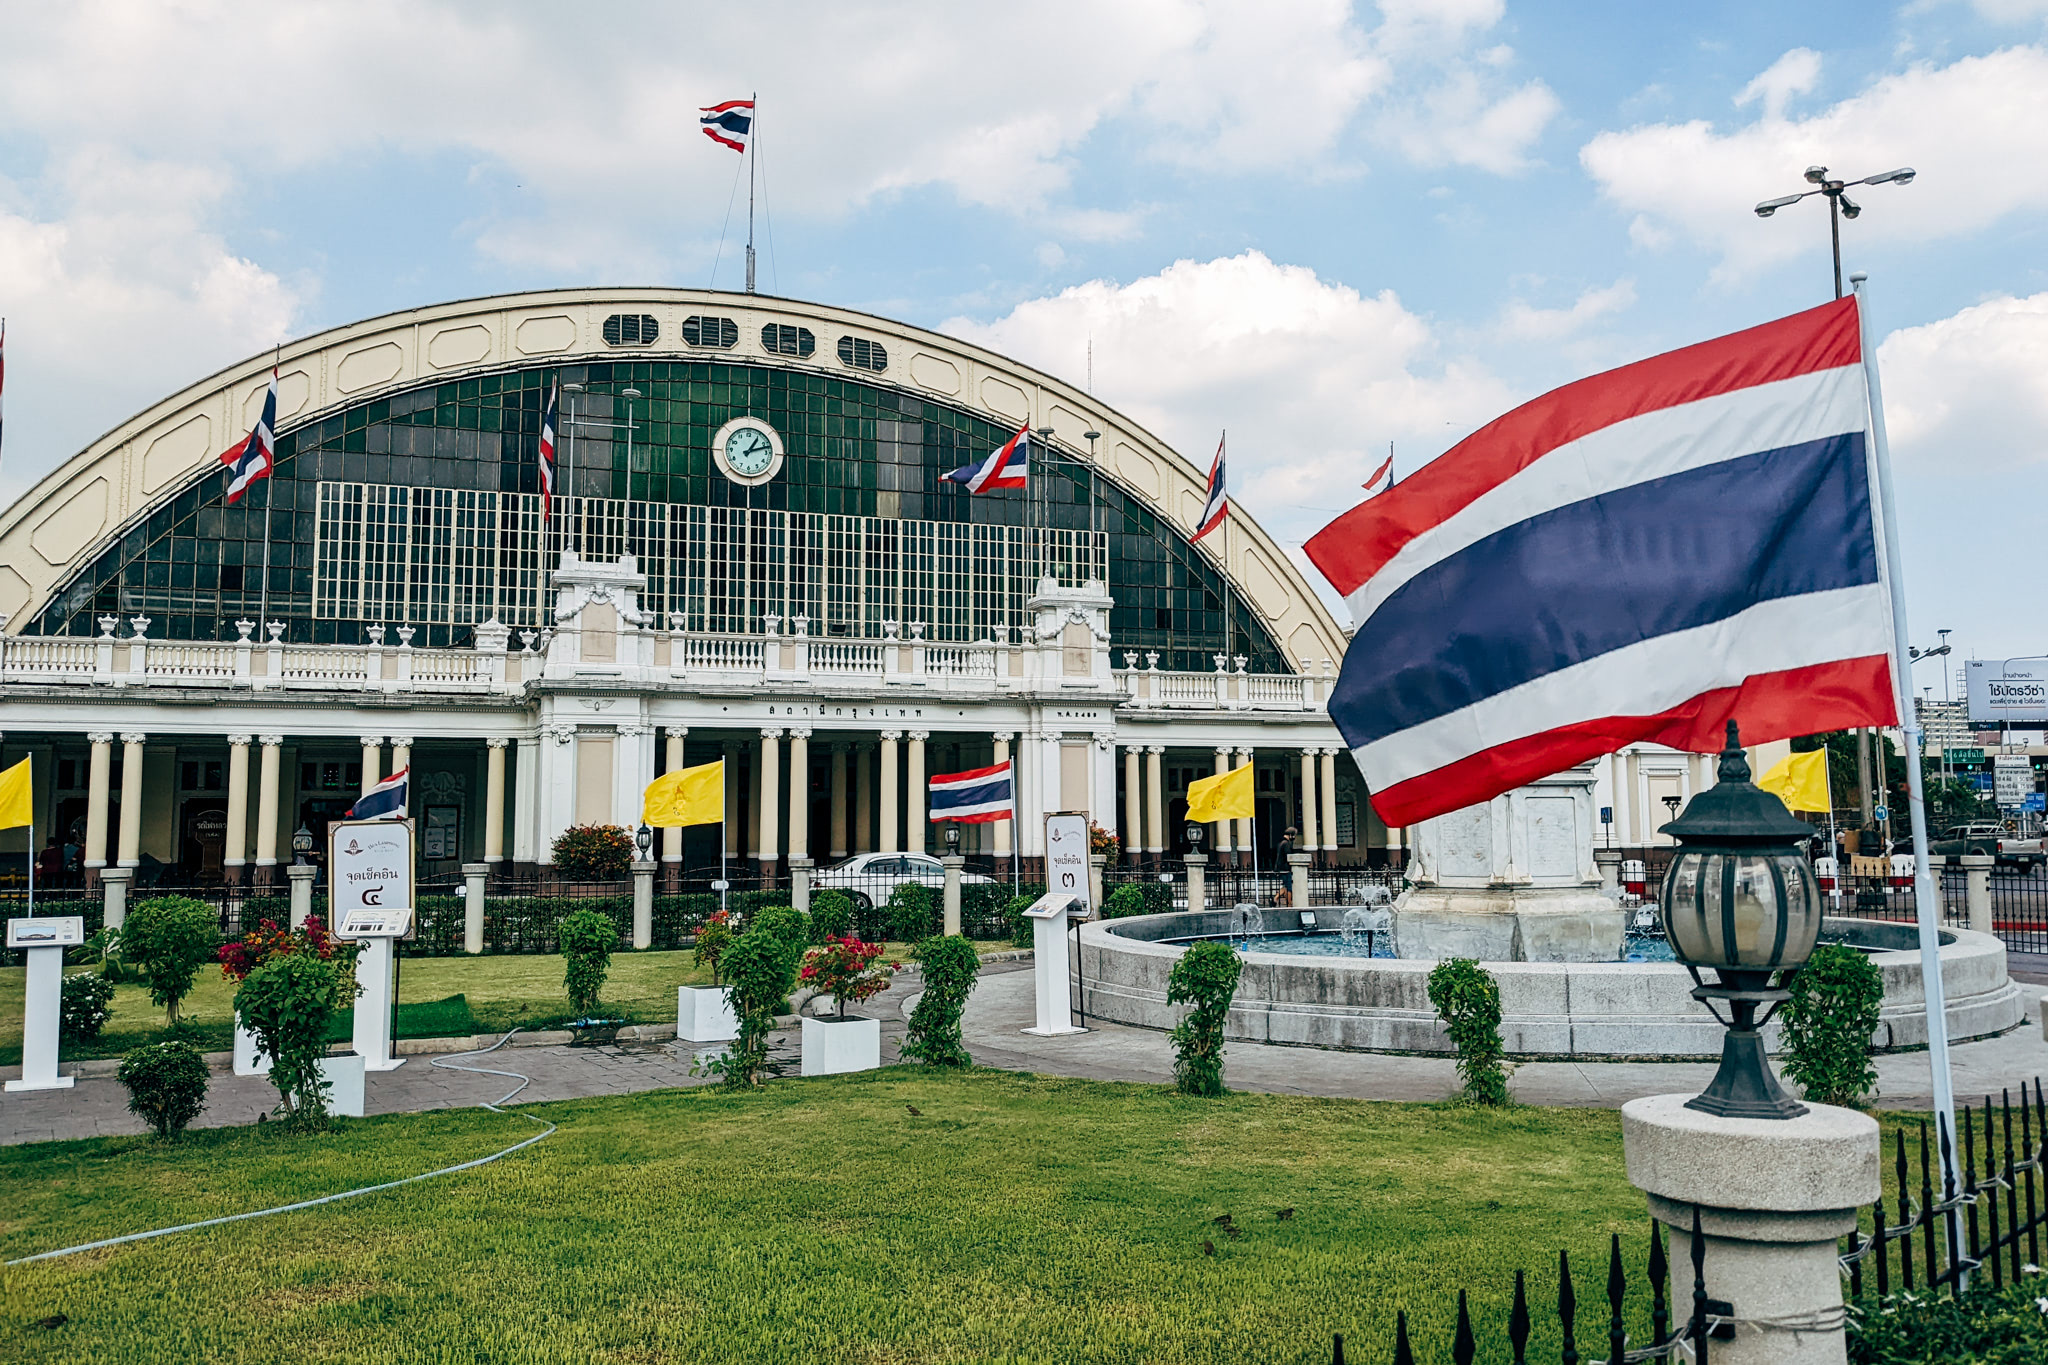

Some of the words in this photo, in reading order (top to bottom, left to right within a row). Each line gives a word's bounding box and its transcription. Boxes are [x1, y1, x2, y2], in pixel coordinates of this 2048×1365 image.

[1988, 683, 2045, 696] ใช้บัตรวีซ่า
[769, 704, 922, 719] สถานีกรุงเทพ
[1053, 853, 1082, 868] จุดเช็คอิน
[346, 867, 399, 885] จุดเช็คอิน
[1062, 873, 1075, 888] ๓
[362, 885, 384, 906] ๔
